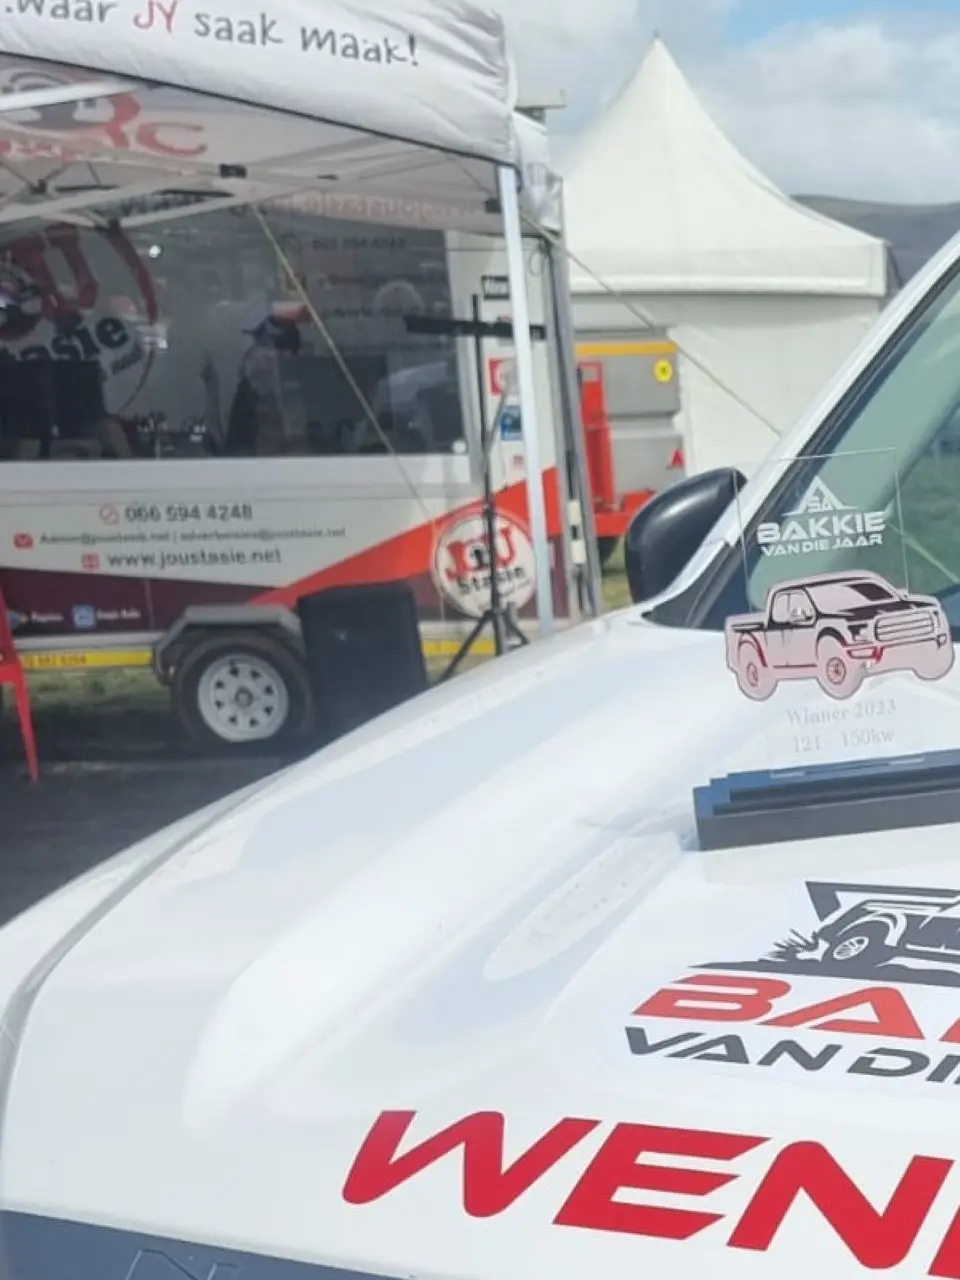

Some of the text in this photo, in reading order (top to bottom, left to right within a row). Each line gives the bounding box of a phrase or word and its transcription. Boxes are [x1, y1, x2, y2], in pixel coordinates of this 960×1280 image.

[134, 0, 178, 34] JY
[194, 12, 284, 46] saak
[301, 26, 418, 67] maak!
[166, 504, 201, 522] 594
[206, 504, 253, 522] 4248
[757, 511, 887, 544] BAKKIE
[761, 533, 884, 556] VAN DIE JAAR
[785, 698, 898, 725] Winner 2023
[624, 1026, 844, 1073] VAN
